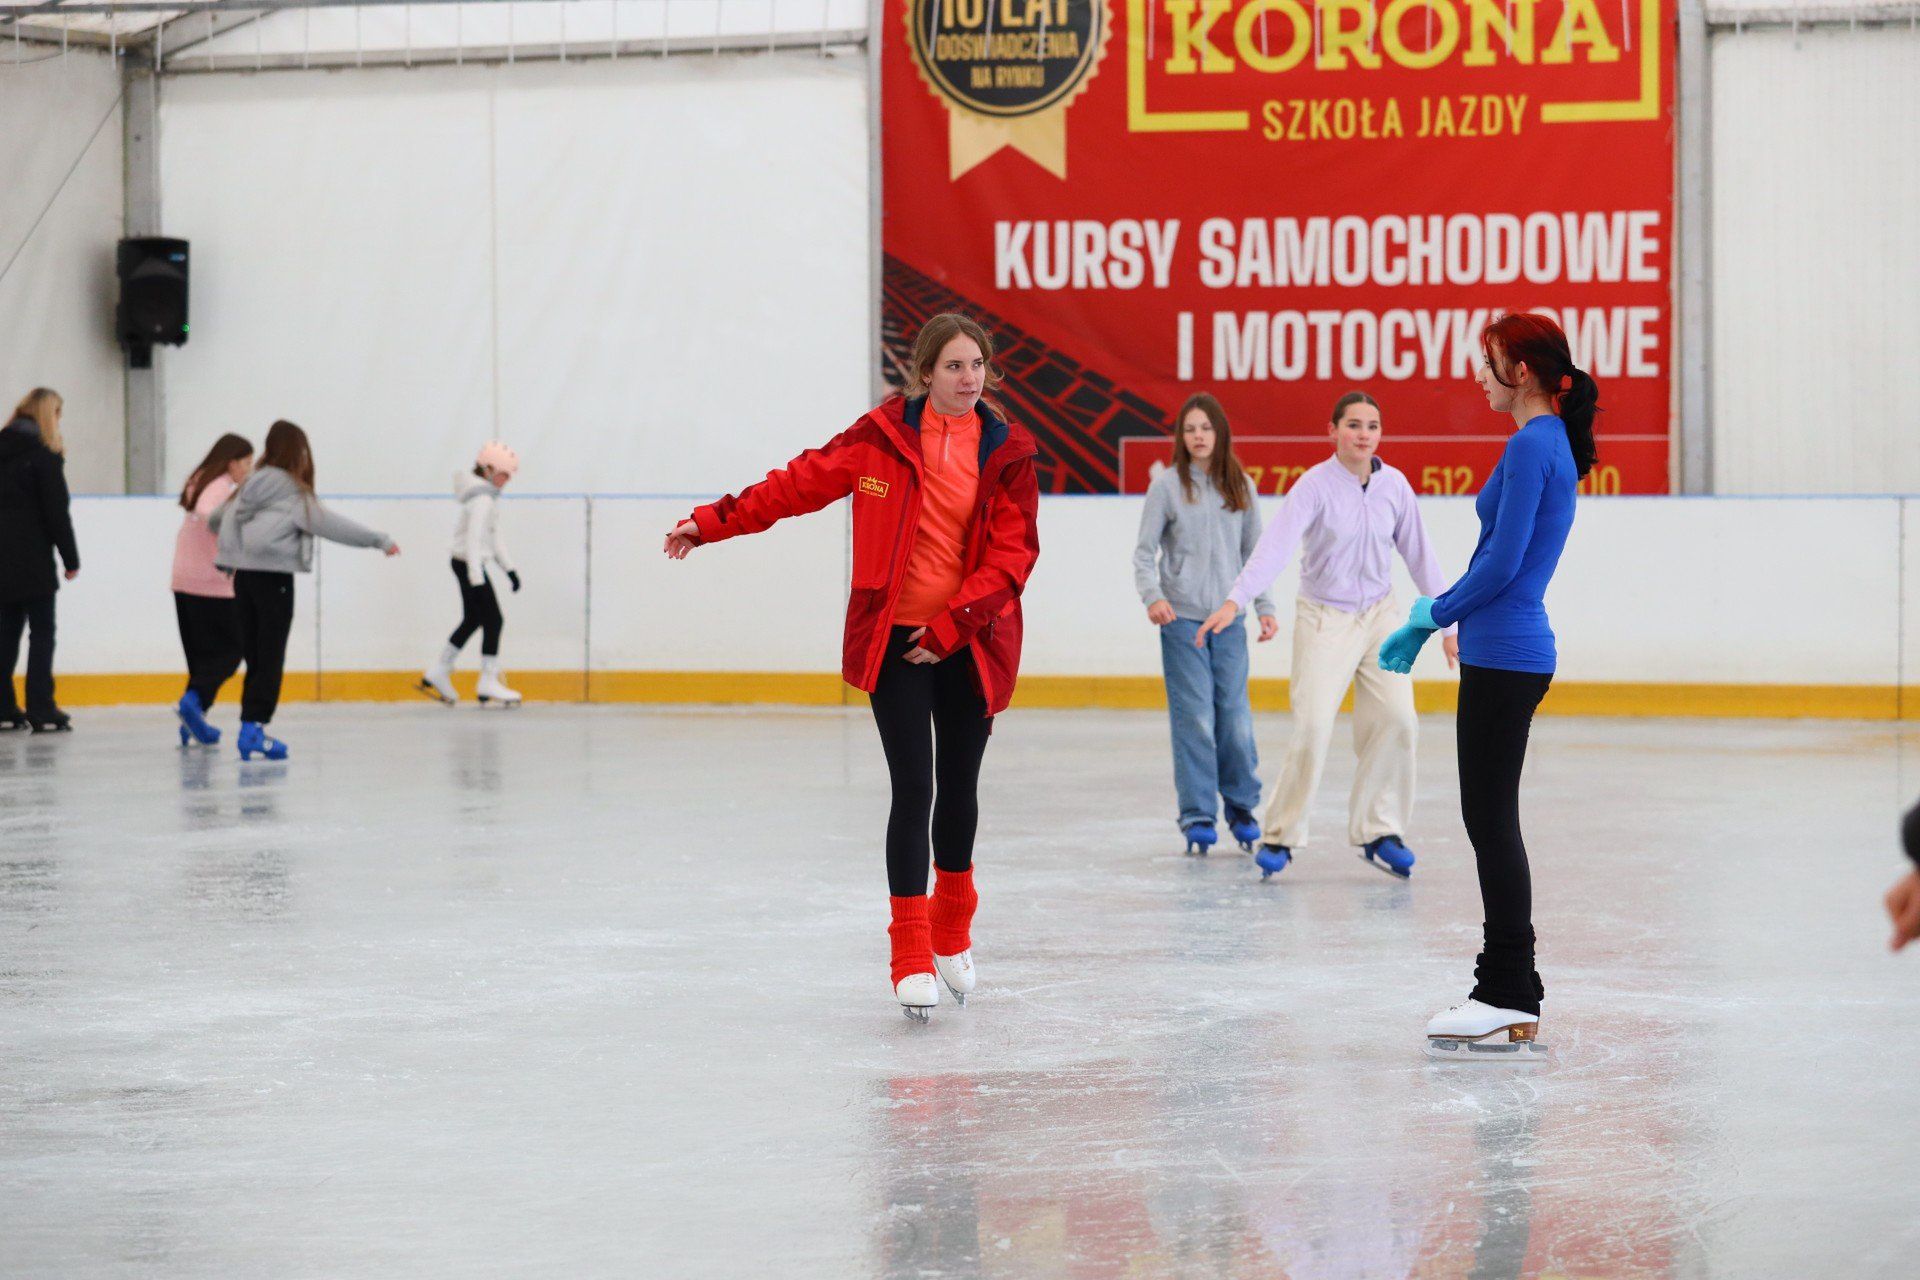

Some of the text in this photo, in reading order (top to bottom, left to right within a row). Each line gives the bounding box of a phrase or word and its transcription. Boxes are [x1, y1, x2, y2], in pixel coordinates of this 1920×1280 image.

[1165, 0, 1620, 74] KORONA
[1262, 94, 1529, 141] SZKOŁA JAZDY
[995, 211, 1660, 289] KURSY SAMOCHODOWE
[1177, 306, 1660, 381] I MOTOCYKWE
[1422, 465, 1473, 495] 512
